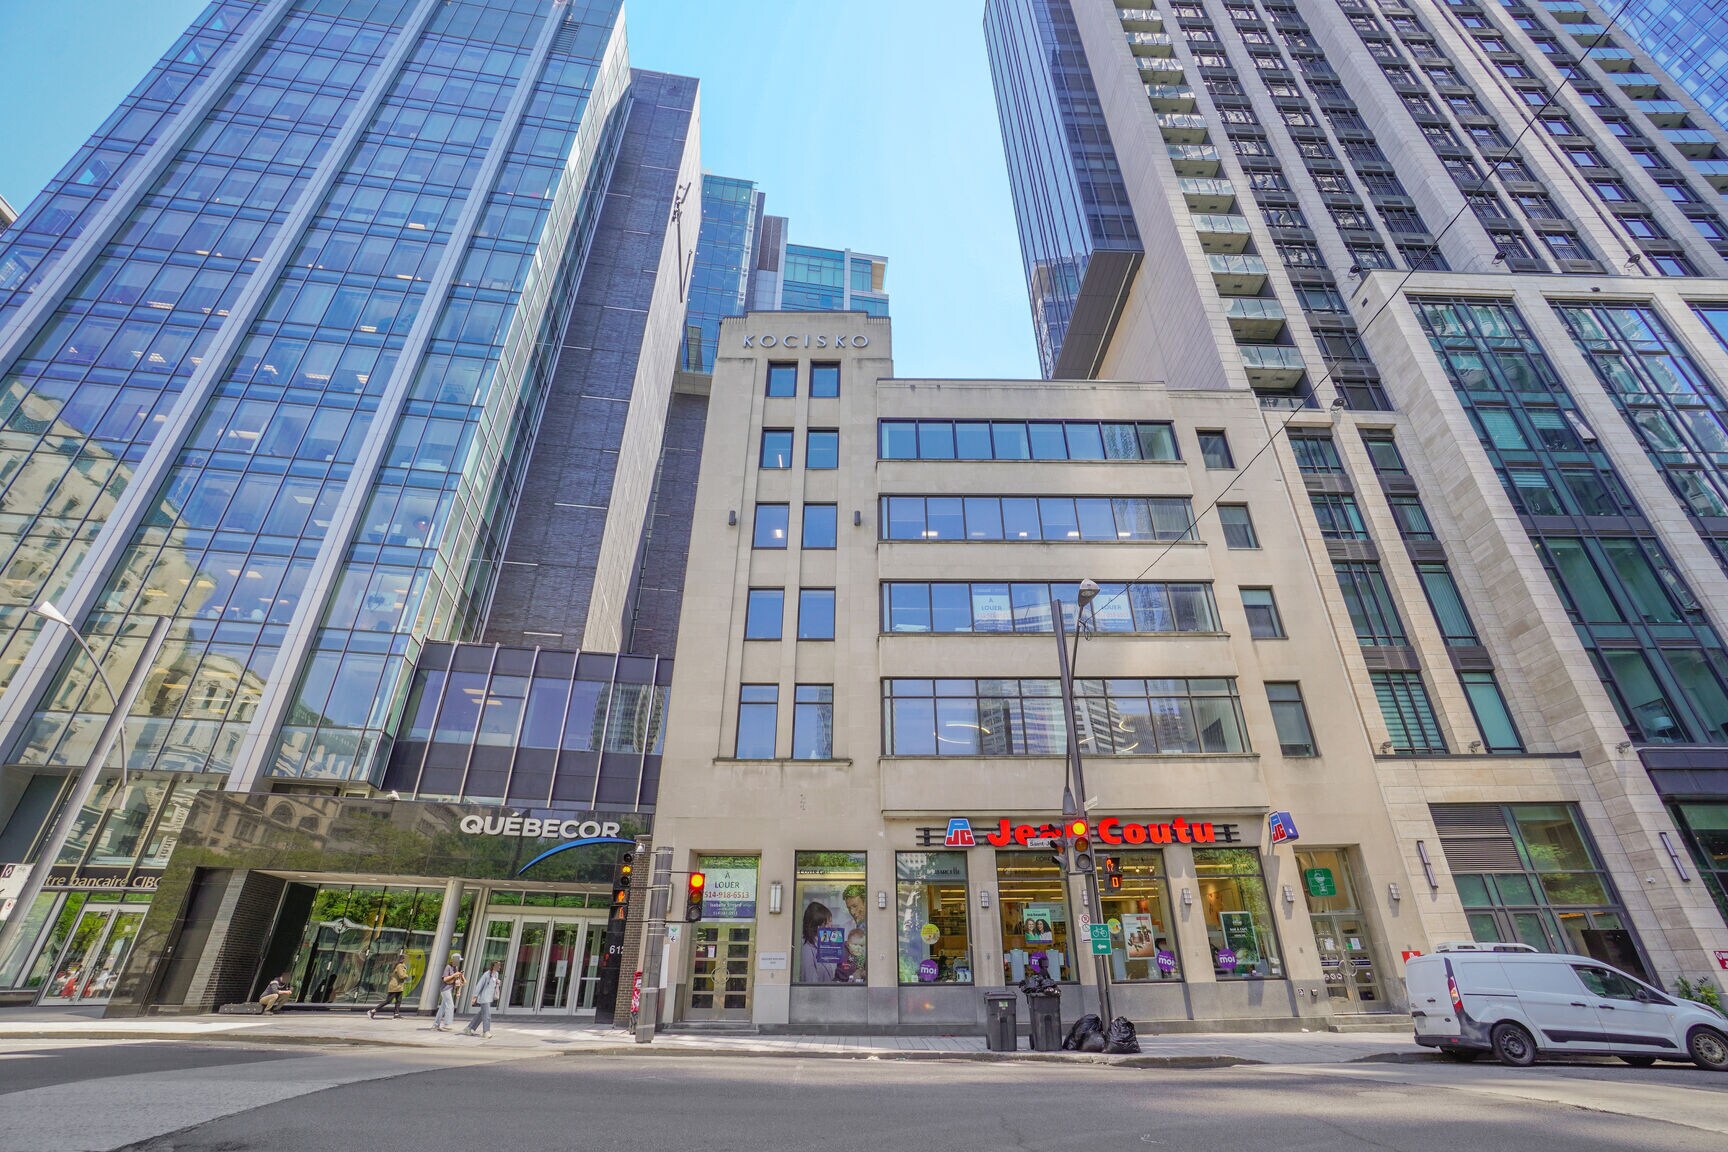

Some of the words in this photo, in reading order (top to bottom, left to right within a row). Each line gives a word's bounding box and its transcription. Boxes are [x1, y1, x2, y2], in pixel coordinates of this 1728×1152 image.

[743, 334, 869, 349] KOCISKO
[460, 811, 621, 839] QUÉBECOR
[986, 819, 1074, 847] Jea
[1098, 816, 1216, 844] Coutu
[45, 876, 66, 886] tre
[70, 875, 128, 887] bancaire
[715, 881, 740, 889] LOUER
